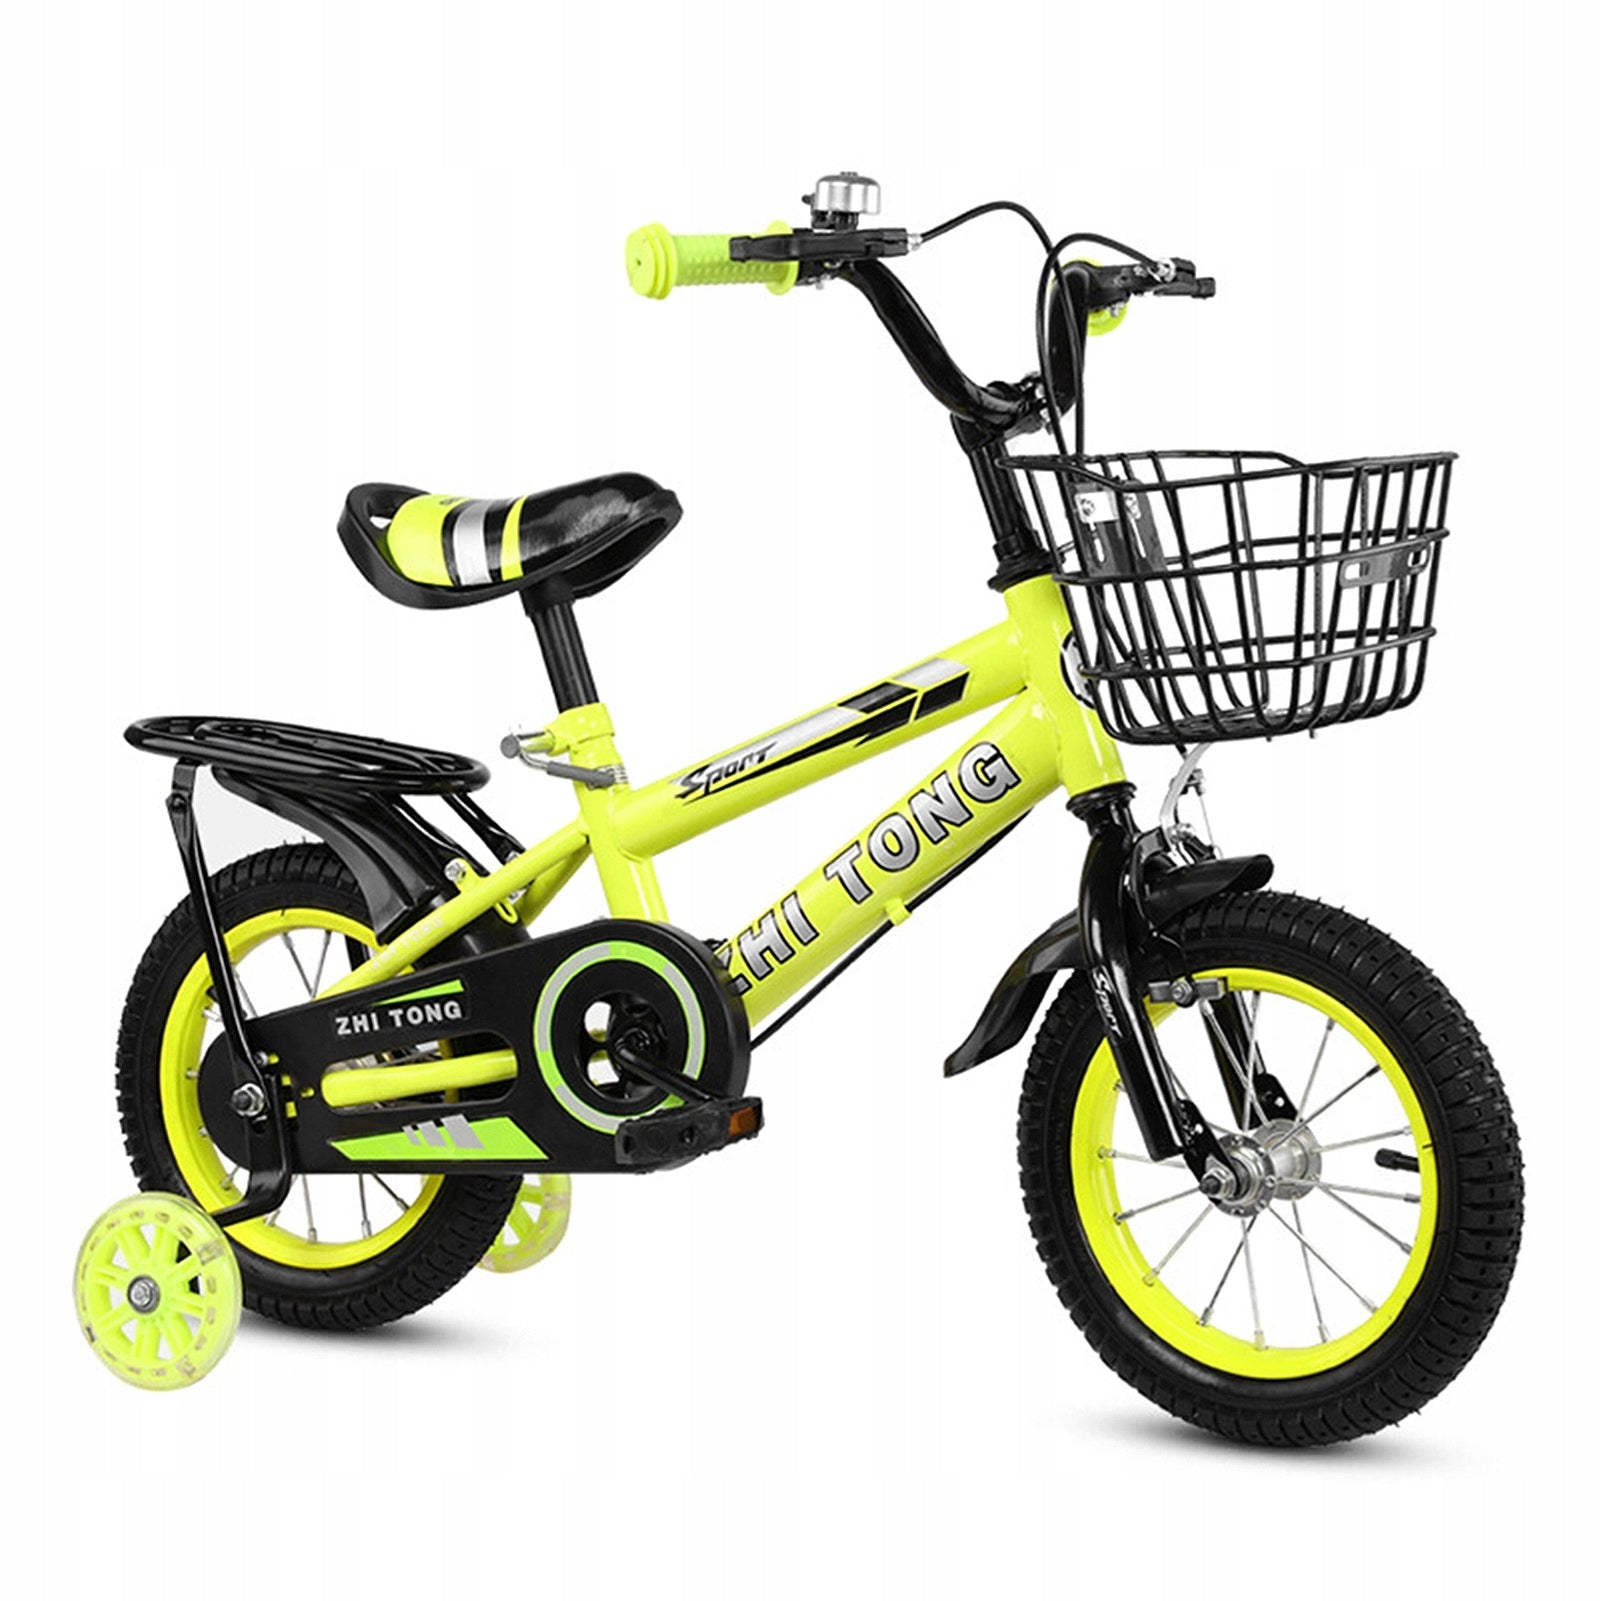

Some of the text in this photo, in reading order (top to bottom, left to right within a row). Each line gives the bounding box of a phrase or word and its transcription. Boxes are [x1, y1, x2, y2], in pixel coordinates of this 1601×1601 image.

[823, 741, 1022, 904] TONG
[335, 1001, 462, 1035] ZHI TONG
